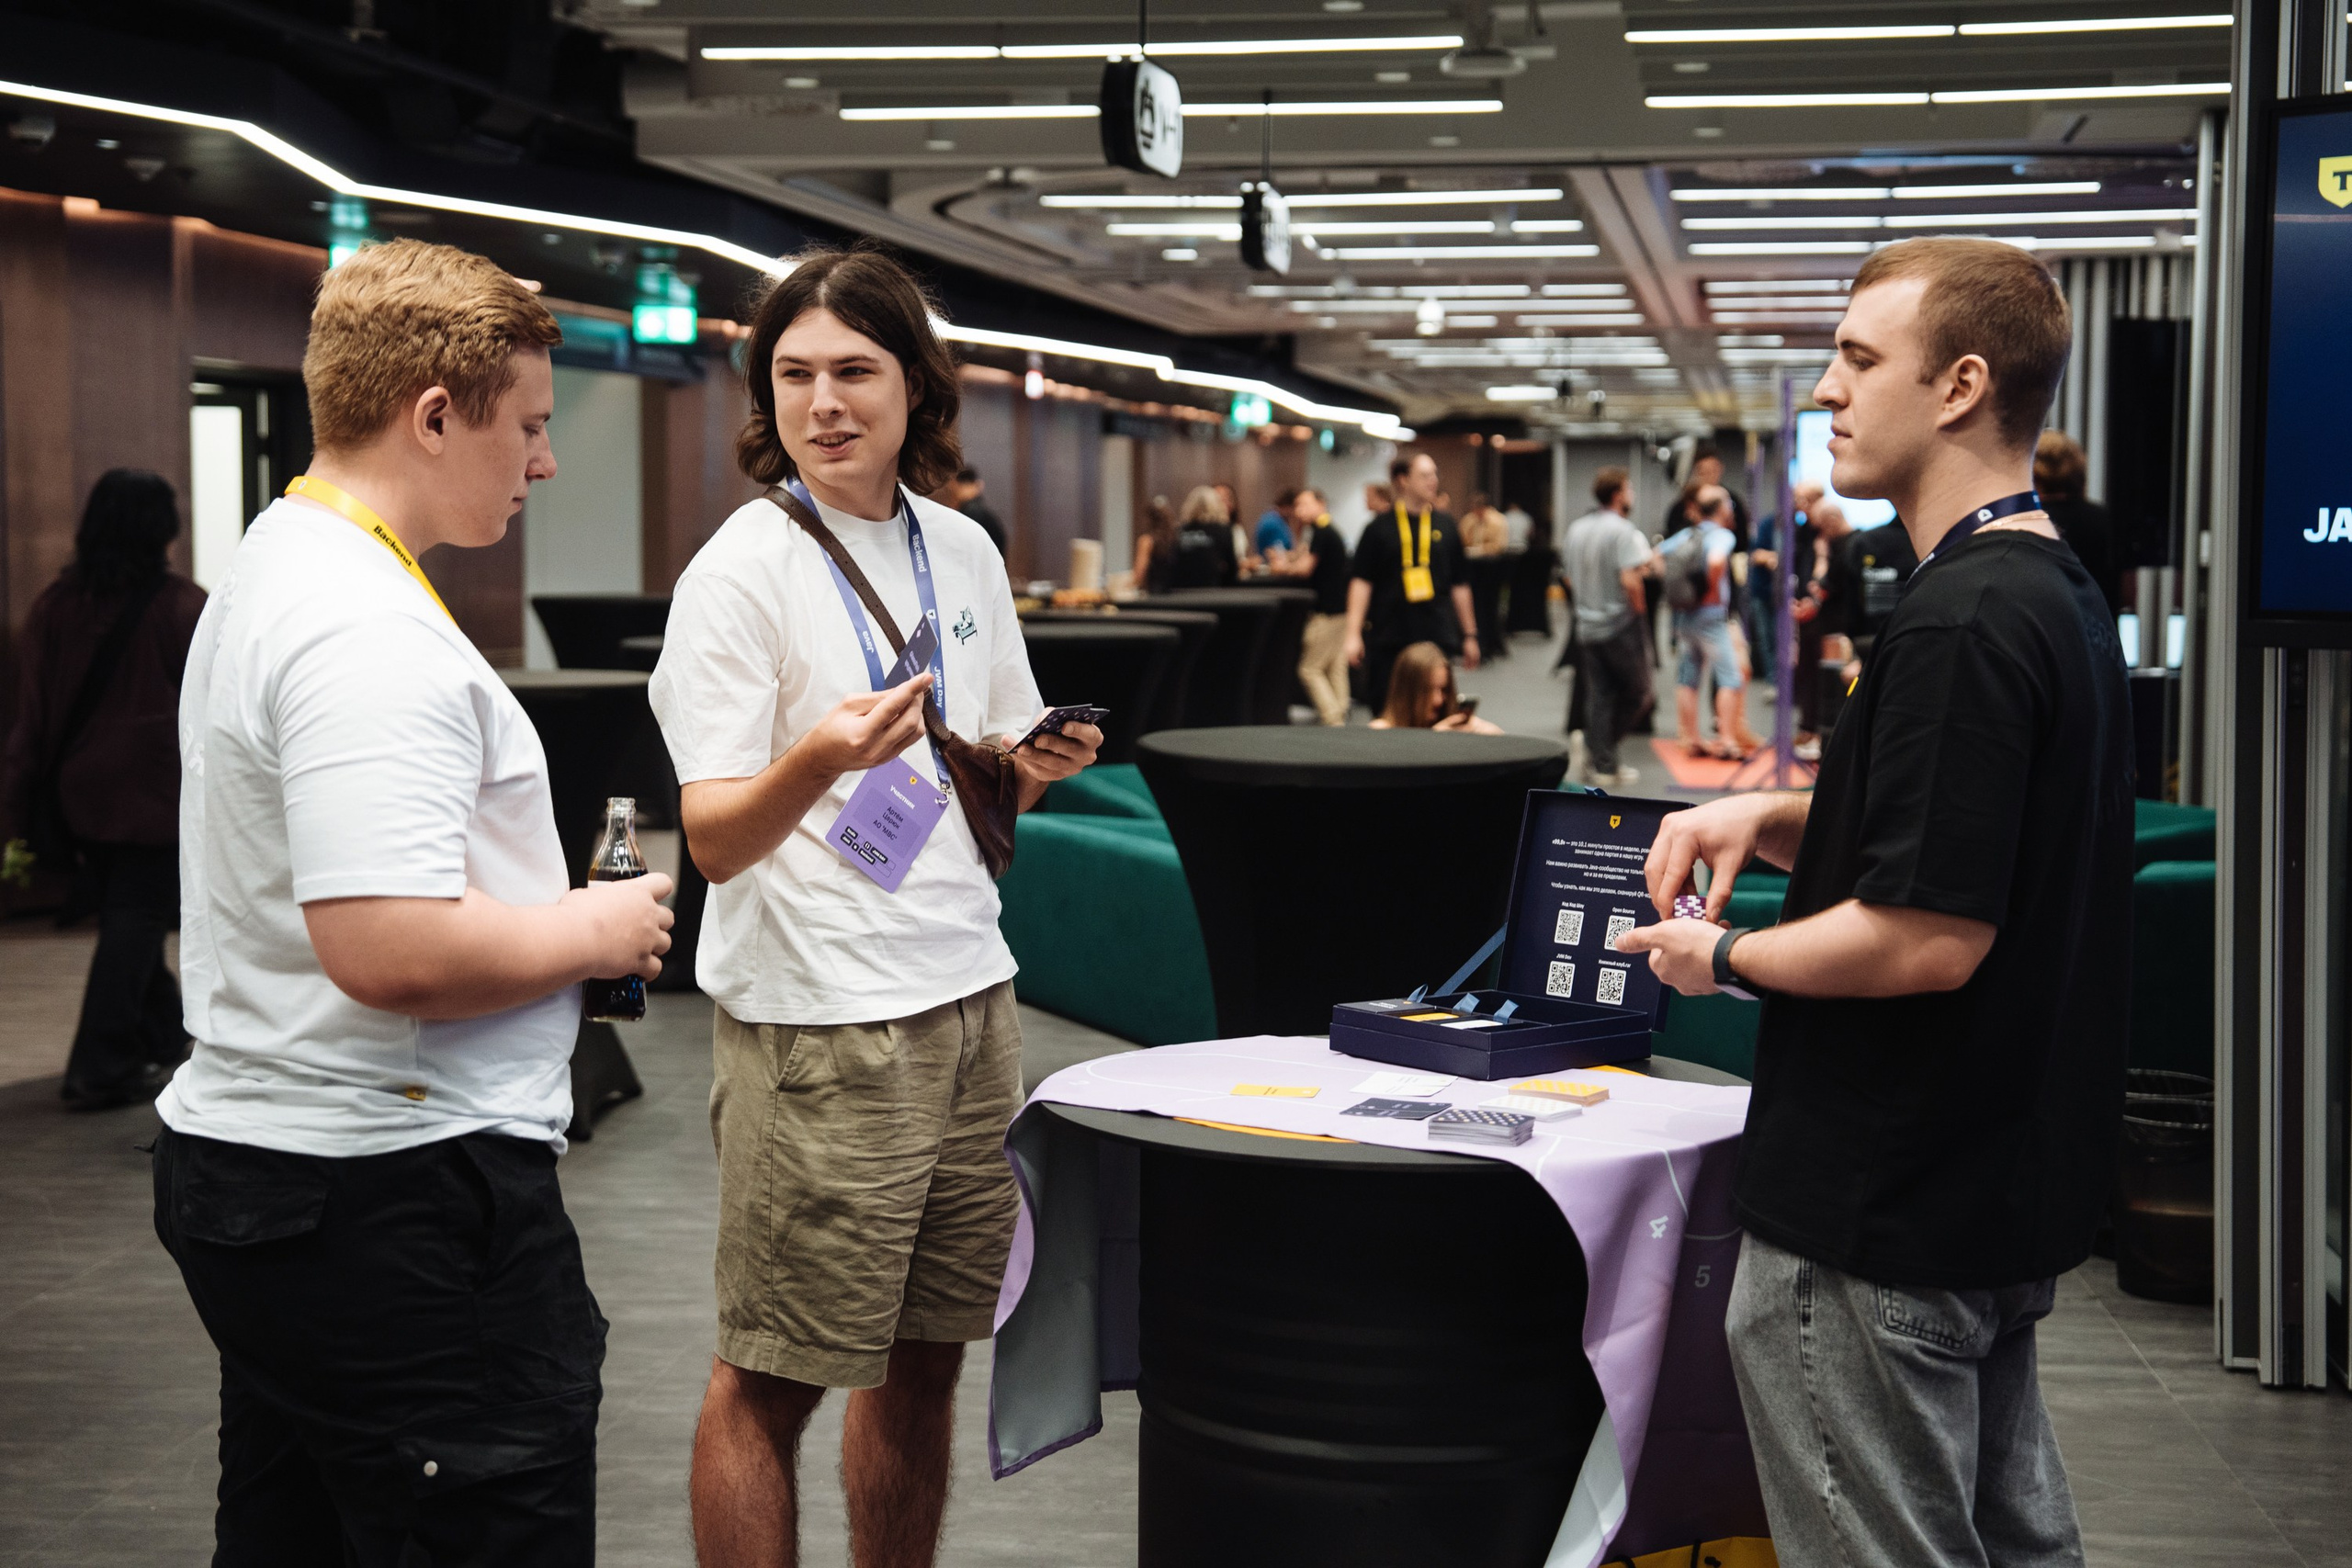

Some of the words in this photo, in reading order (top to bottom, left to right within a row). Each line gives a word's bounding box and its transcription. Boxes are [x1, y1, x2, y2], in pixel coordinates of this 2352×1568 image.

[2302, 506, 2352, 544] JA
[373, 525, 413, 568] Backend
[911, 533, 927, 573] Backend
[862, 630, 875, 653] Java
[933, 666, 943, 688] JVM
[935, 690, 944, 709] Day
[889, 784, 915, 809] Участник
[887, 806, 904, 823] Артём
[1649, 1215, 1669, 1239] 4
[1694, 1265, 1711, 1288] 5
